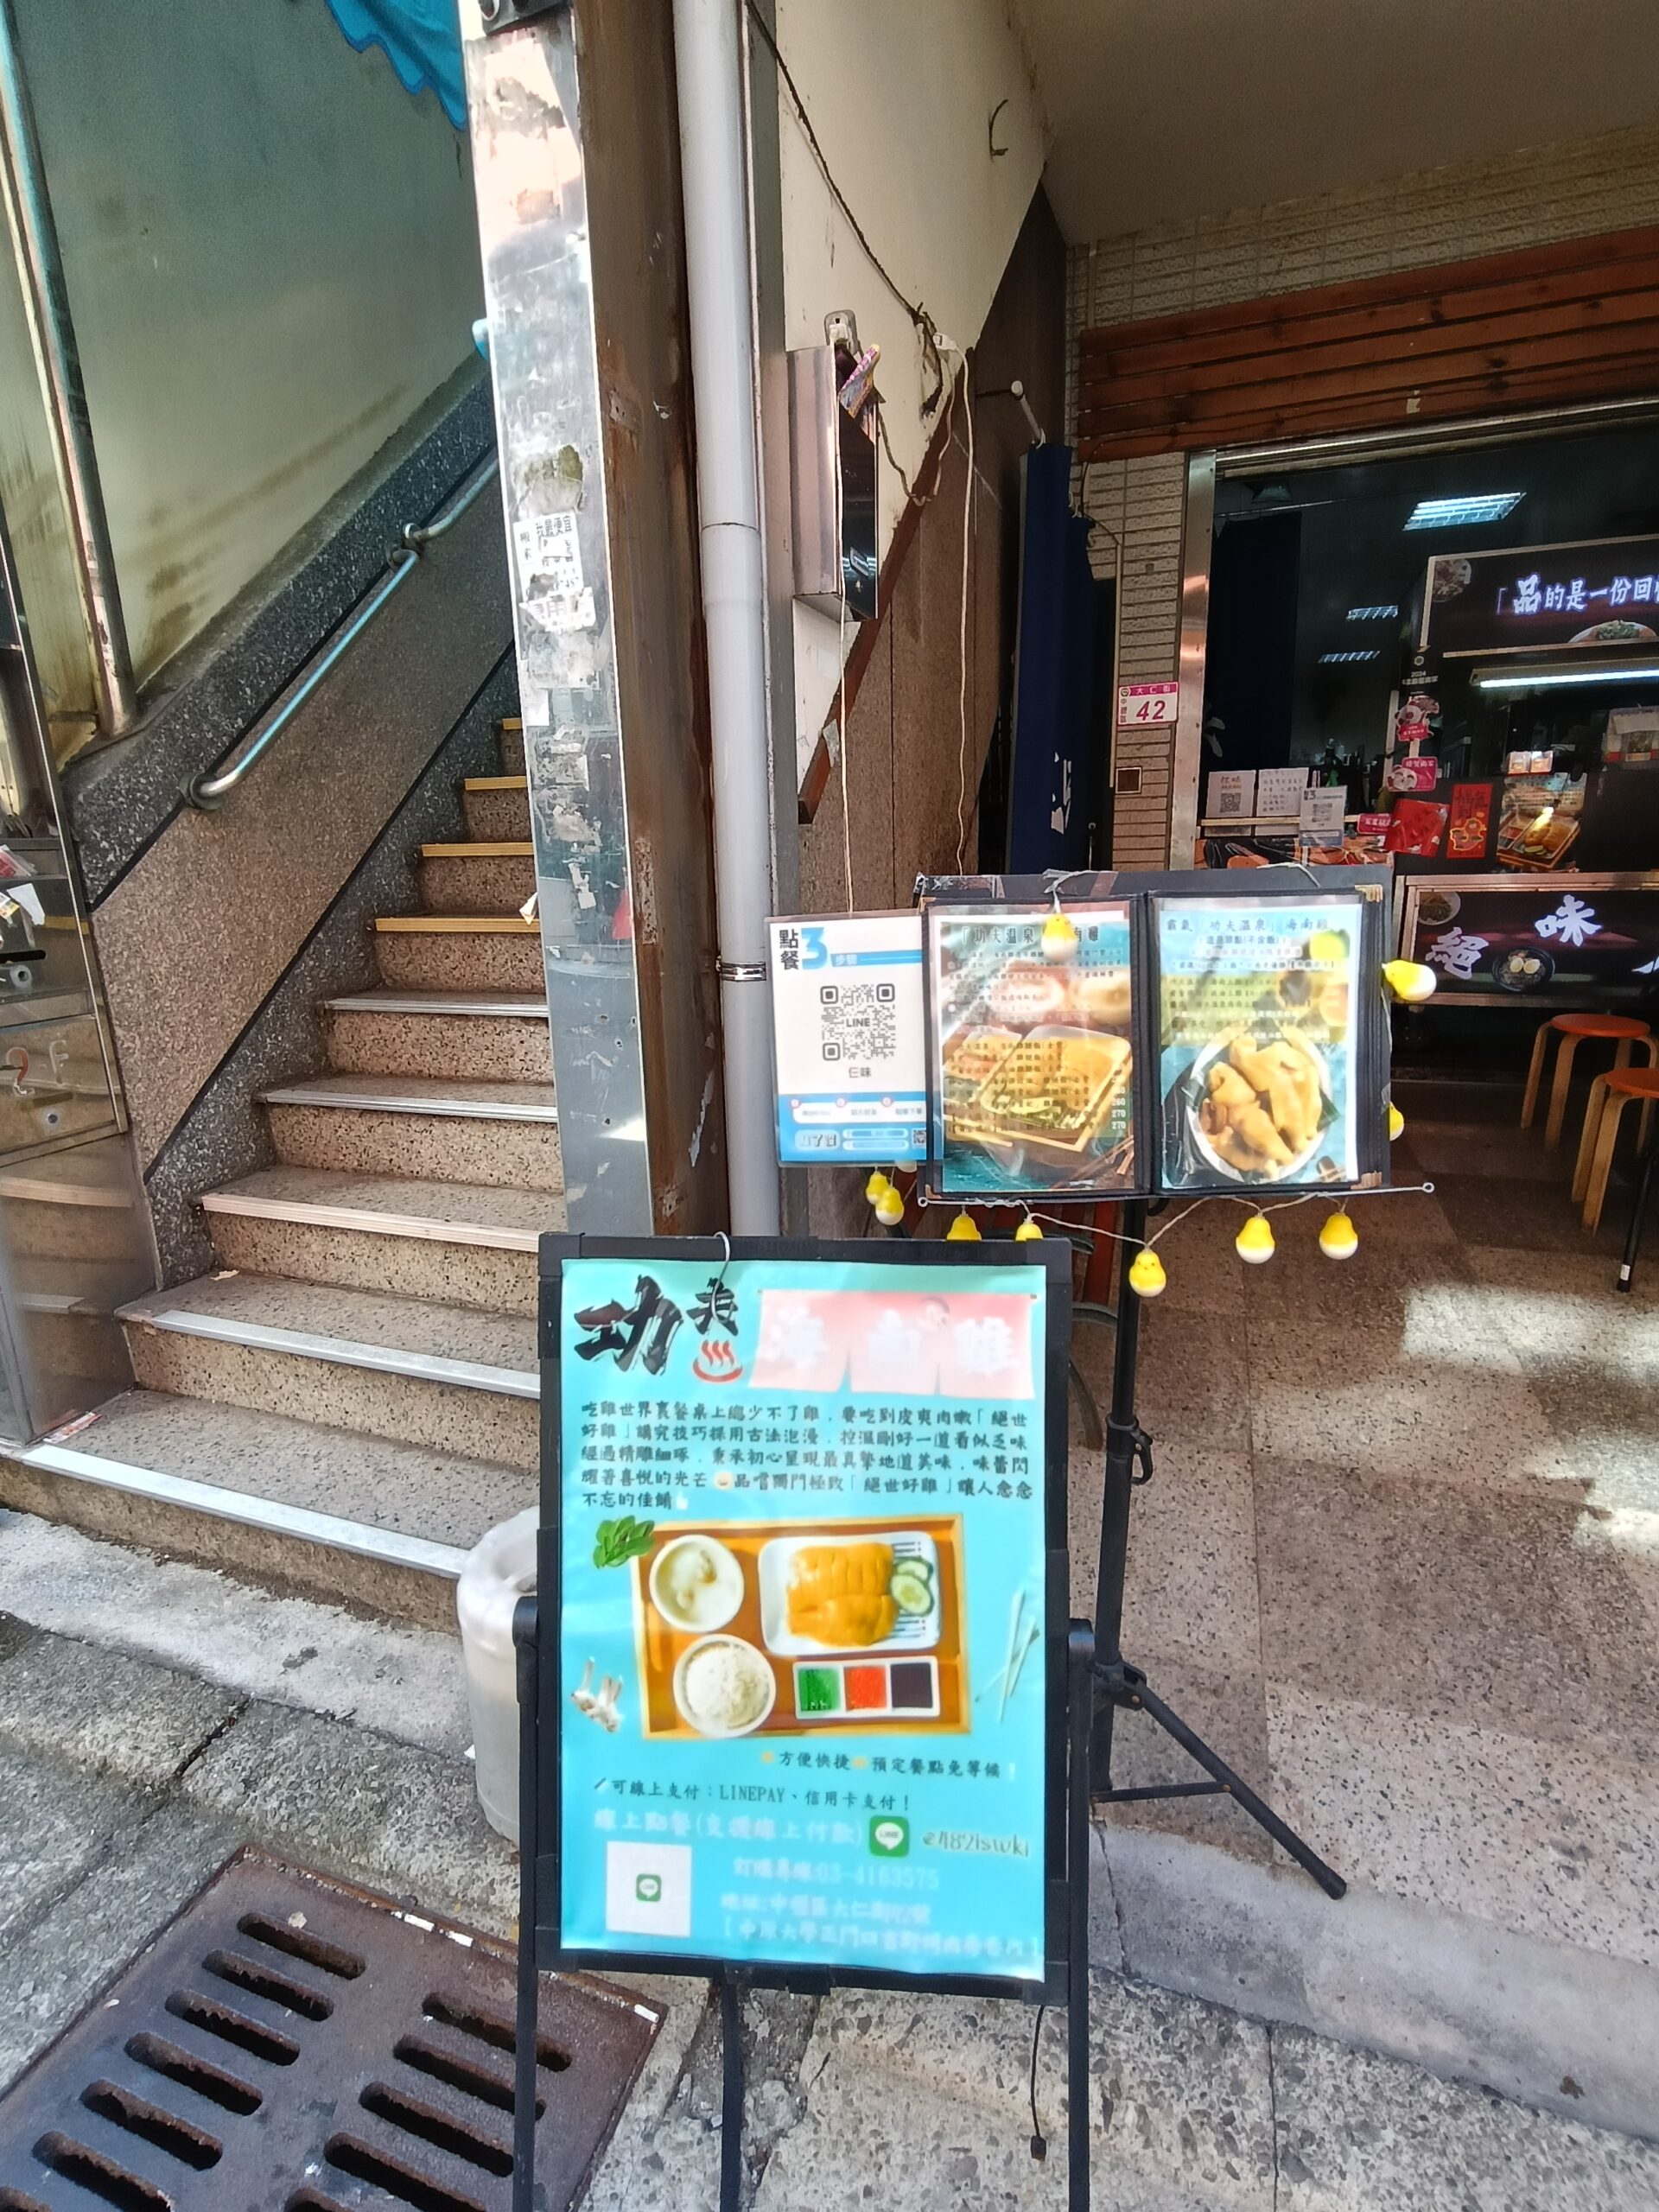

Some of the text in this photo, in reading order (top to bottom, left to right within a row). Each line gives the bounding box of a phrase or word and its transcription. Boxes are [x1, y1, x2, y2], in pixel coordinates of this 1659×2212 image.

[1135, 701, 1166, 721] 42
[779, 928, 799, 970] 點餐
[800, 926, 828, 969] 3
[846, 1017, 871, 1028] LINE
